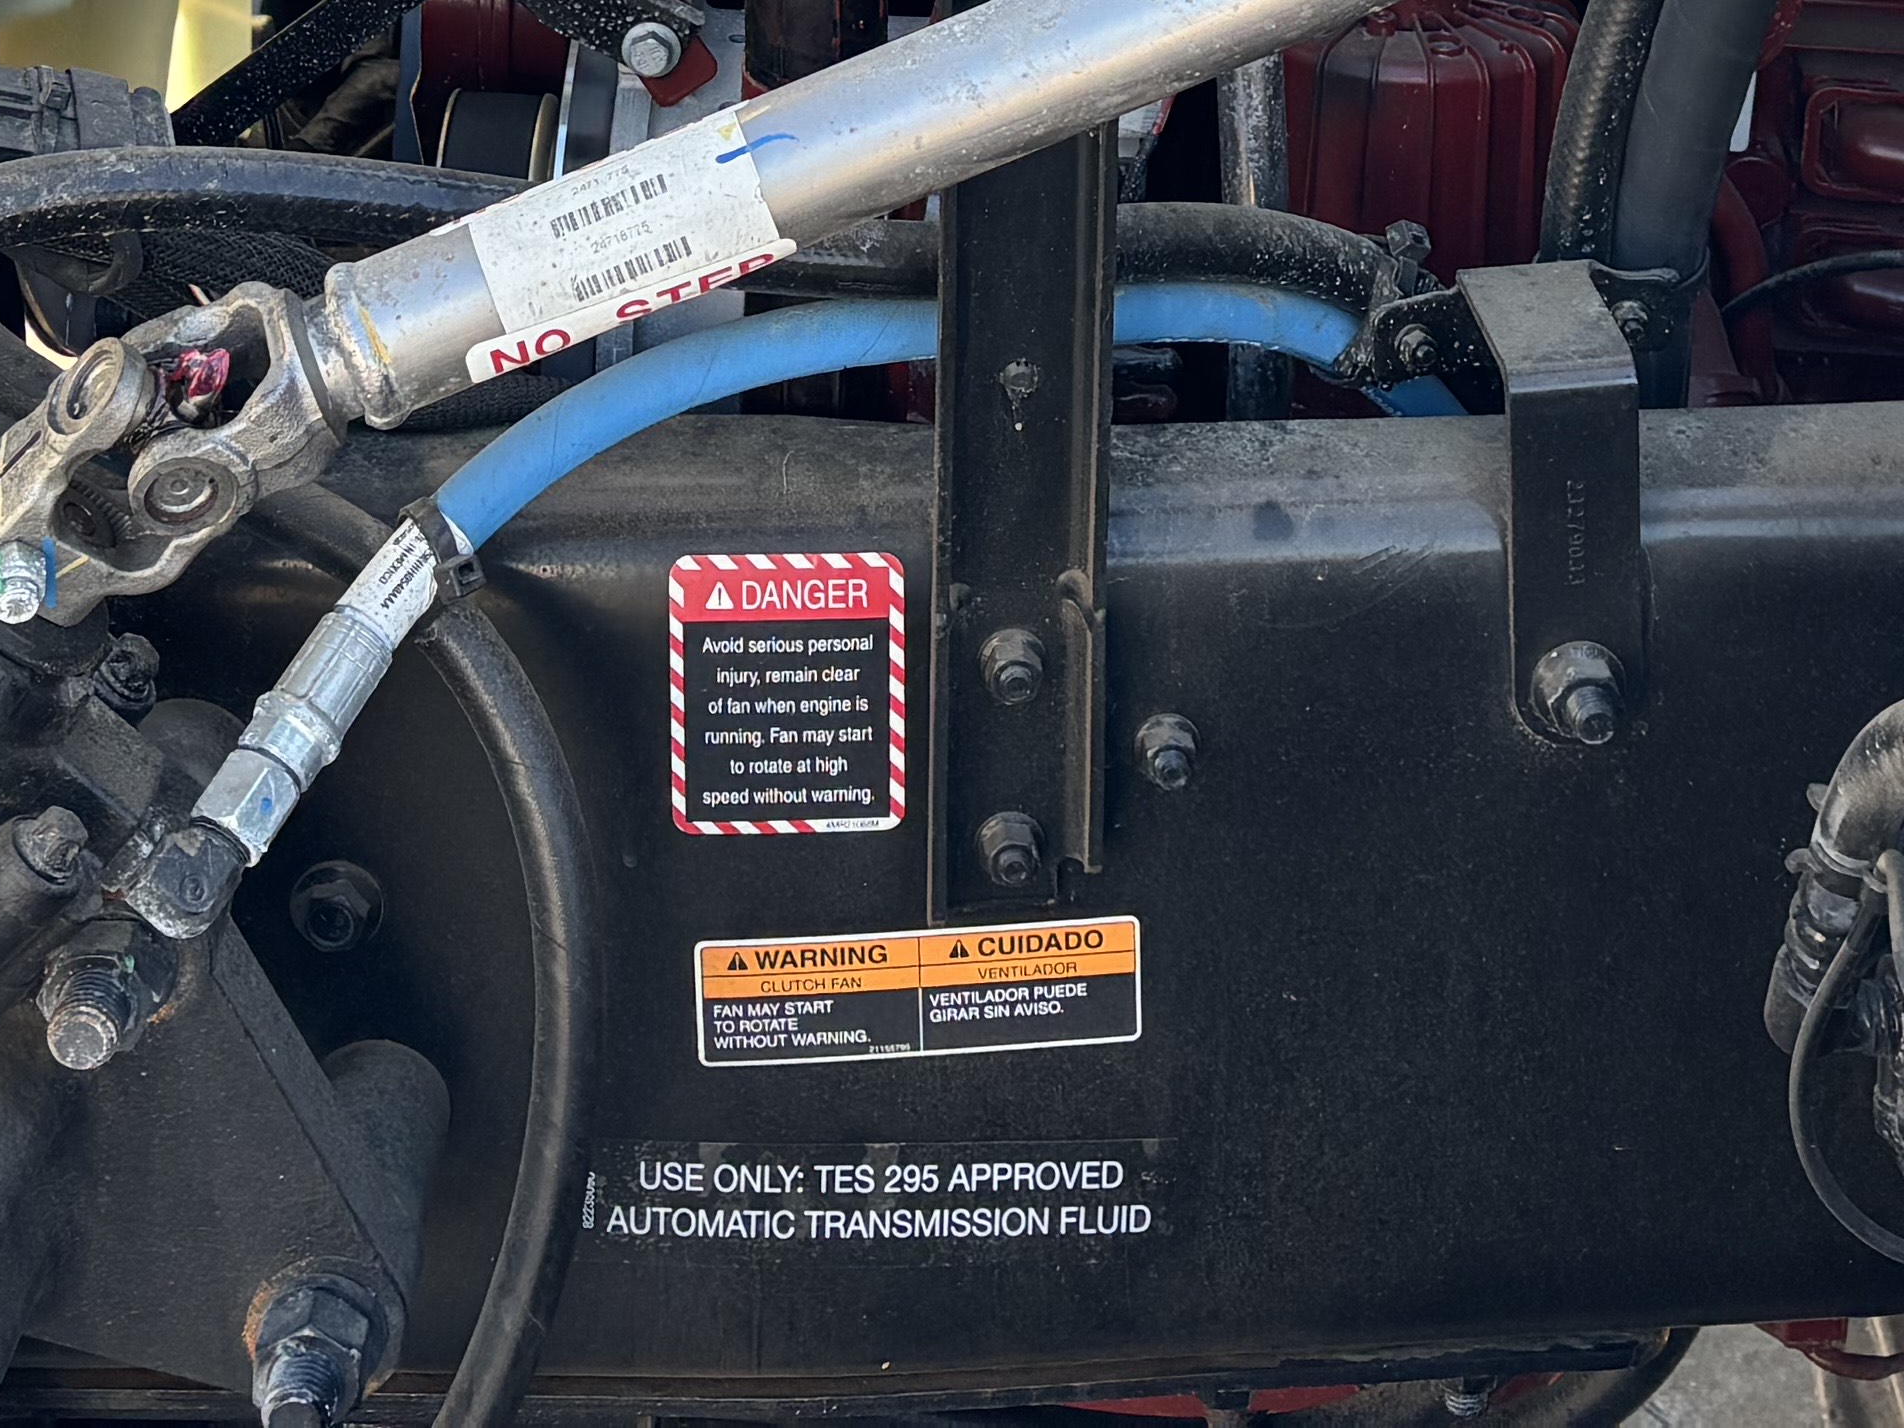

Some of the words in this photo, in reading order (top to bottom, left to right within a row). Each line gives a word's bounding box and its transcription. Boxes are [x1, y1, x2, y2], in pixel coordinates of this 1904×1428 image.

[571, 165, 630, 197] 2471775
[590, 220, 652, 255] 24718775
[489, 328, 572, 374] NO
[616, 253, 774, 322] STEP
[741, 579, 868, 610] DANGER
[702, 637, 744, 654] Avoid
[748, 636, 804, 653] serious
[808, 634, 874, 655] personal
[717, 667, 761, 687] injury,
[765, 666, 818, 683] remain
[822, 666, 860, 682] clear
[708, 698, 723, 714] of
[727, 697, 750, 714] fan
[754, 697, 795, 714] when
[800, 696, 852, 716] engine
[855, 695, 869, 711] is
[705, 728, 765, 748] running.
[769, 727, 798, 744] Fan
[802, 729, 834, 746] may
[838, 725, 873, 742] start
[730, 759, 745, 775] to
[749, 758, 792, 774] rotate
[796, 757, 811, 773] at
[815, 756, 848, 776] high
[702, 788, 749, 807] speed
[753, 788, 807, 804] without
[811, 785, 875, 805] warning.
[977, 929, 1104, 957] CUIDADO
[754, 944, 888, 970] WARNING
[977, 961, 1077, 980] VENTILADOR
[760, 977, 826, 993] CLUTCH
[831, 977, 862, 989] FAN
[929, 987, 1029, 1007] VENTILADOR
[1033, 983, 1088, 998] PUEDE
[713, 1005, 744, 1019] FAN
[747, 1003, 780, 1017] MAY
[784, 1000, 834, 1016] START
[929, 1006, 980, 1023] GIRAR
[984, 1005, 1010, 1019] SIN
[1014, 1001, 1065, 1017] AVISO.
[713, 1020, 735, 1034] TO
[739, 1017, 799, 1033] ROTATE
[713, 1034, 788, 1050] WITHOUT
[791, 1030, 872, 1046] WARNING.
[638, 1160, 704, 1193] USE
[712, 1163, 806, 1195] ONLY:
[813, 1164, 876, 1195] TES
[883, 1164, 940, 1194] 295
[946, 1160, 1125, 1193] APPROVED
[606, 1204, 797, 1240] AUTOMATIC
[803, 1205, 1050, 1239] TRANSMISSION
[1058, 1203, 1153, 1236] FLUID
